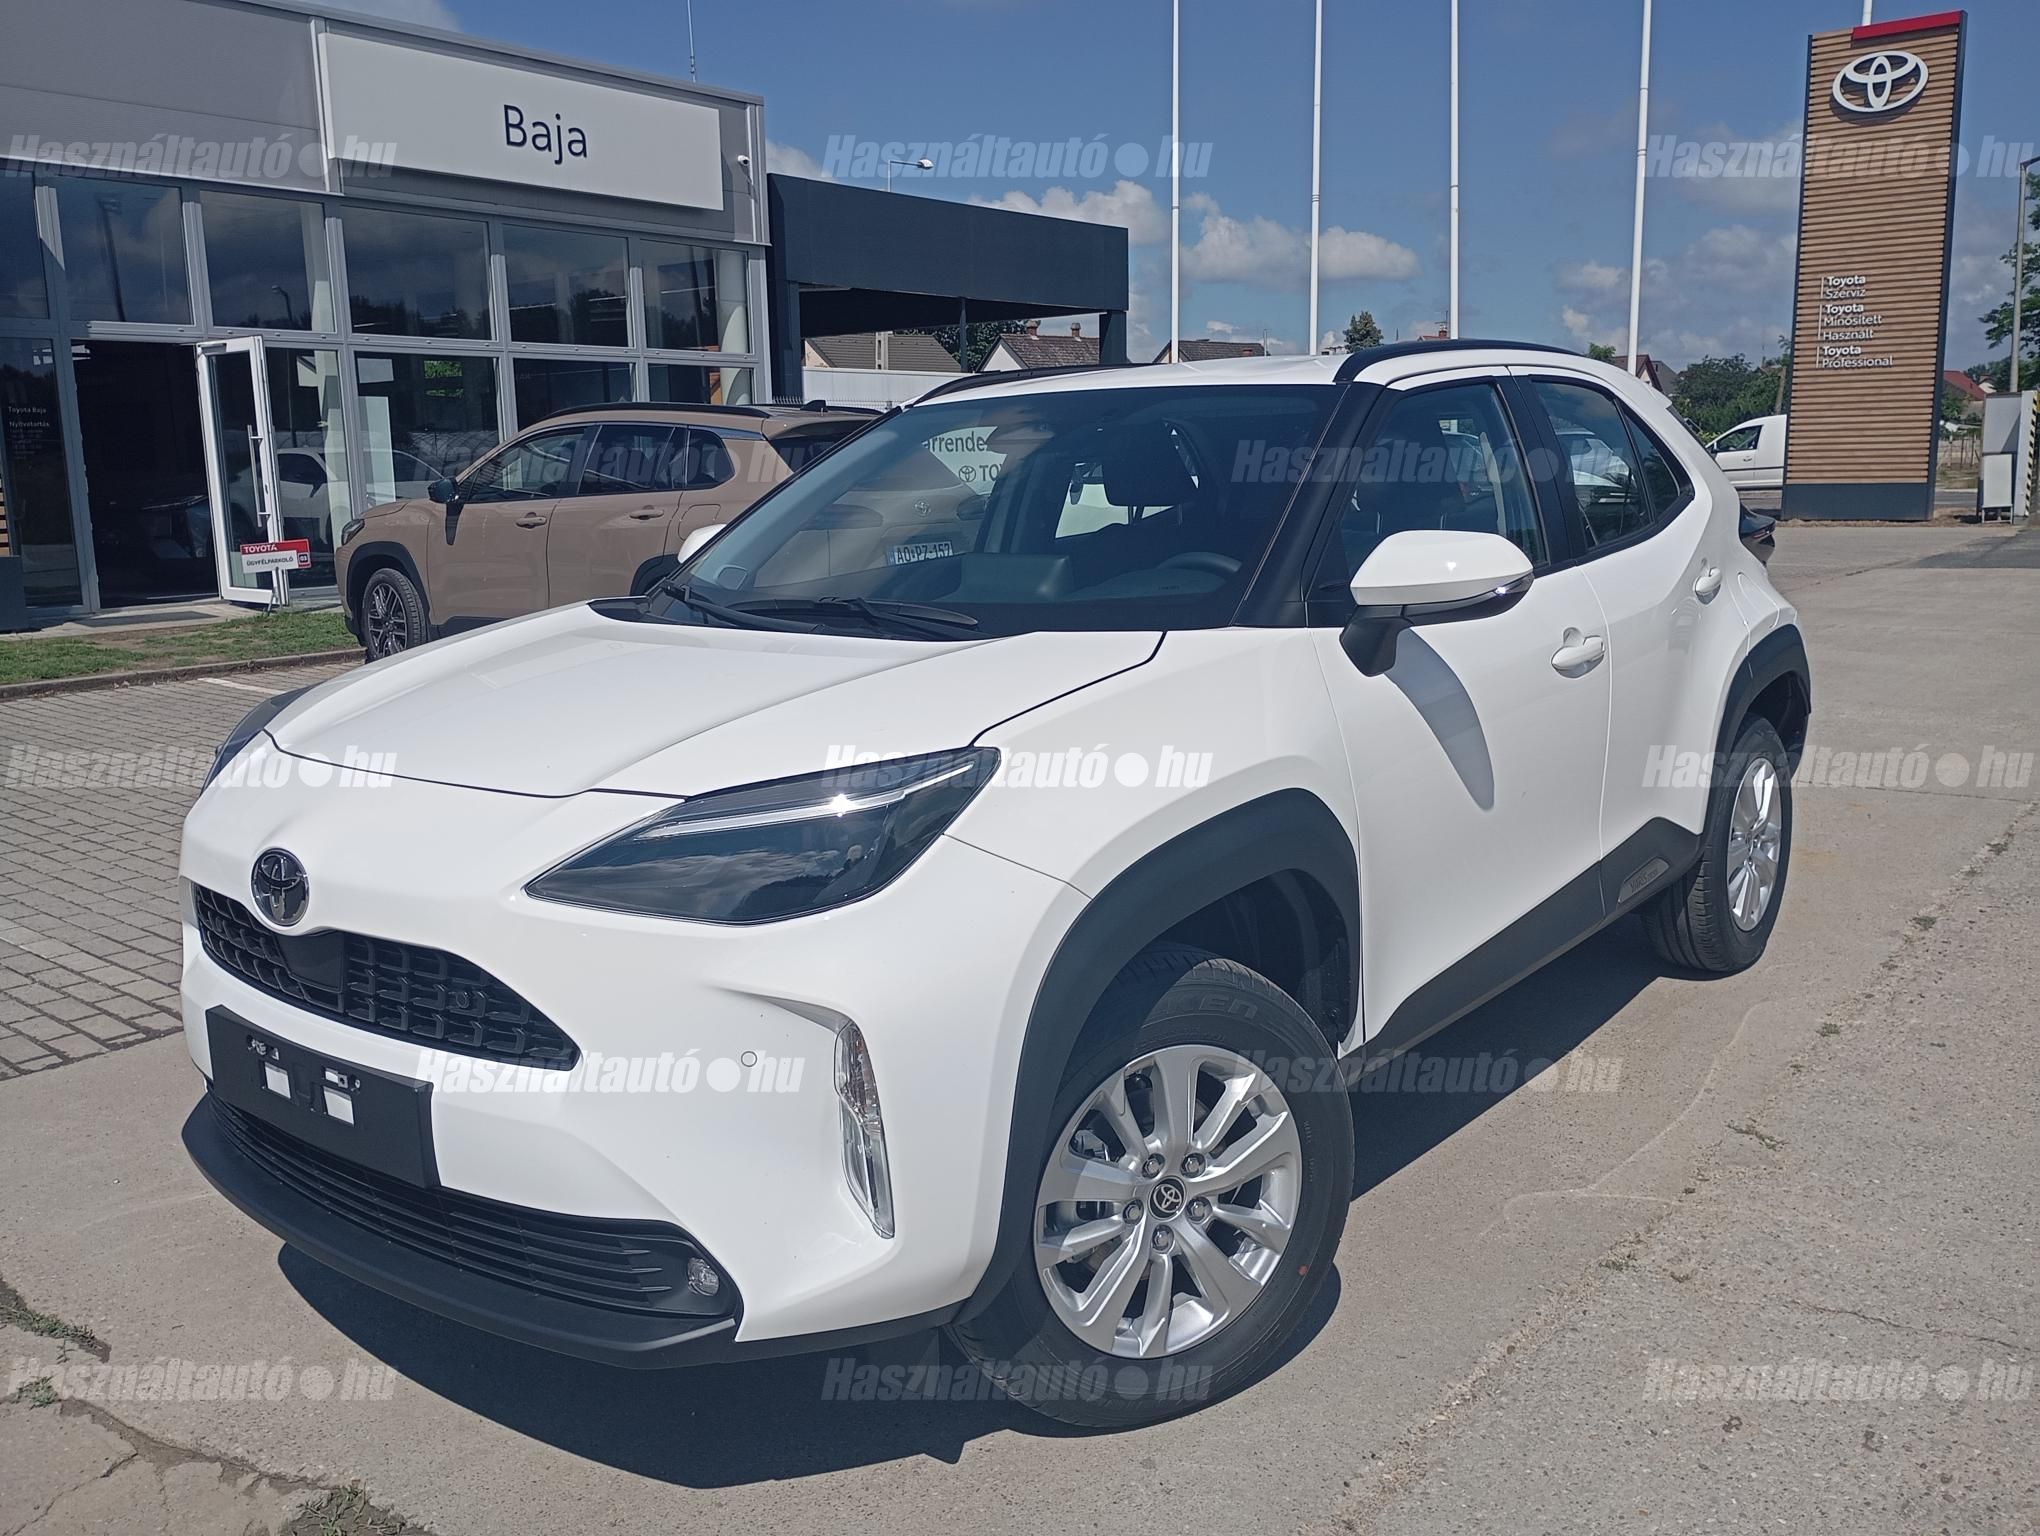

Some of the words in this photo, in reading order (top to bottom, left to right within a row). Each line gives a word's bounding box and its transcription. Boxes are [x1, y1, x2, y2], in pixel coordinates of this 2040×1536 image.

[503, 104, 587, 165] Baja
[1827, 275, 1866, 287] Toyota
[1826, 287, 1866, 299] Szerviz
[1825, 303, 1864, 315] Toyota
[1823, 345, 1861, 357] Toyota
[1822, 355, 1893, 368] Professional
[979, 463, 1001, 481] TO
[243, 544, 278, 554] TOYOTA
